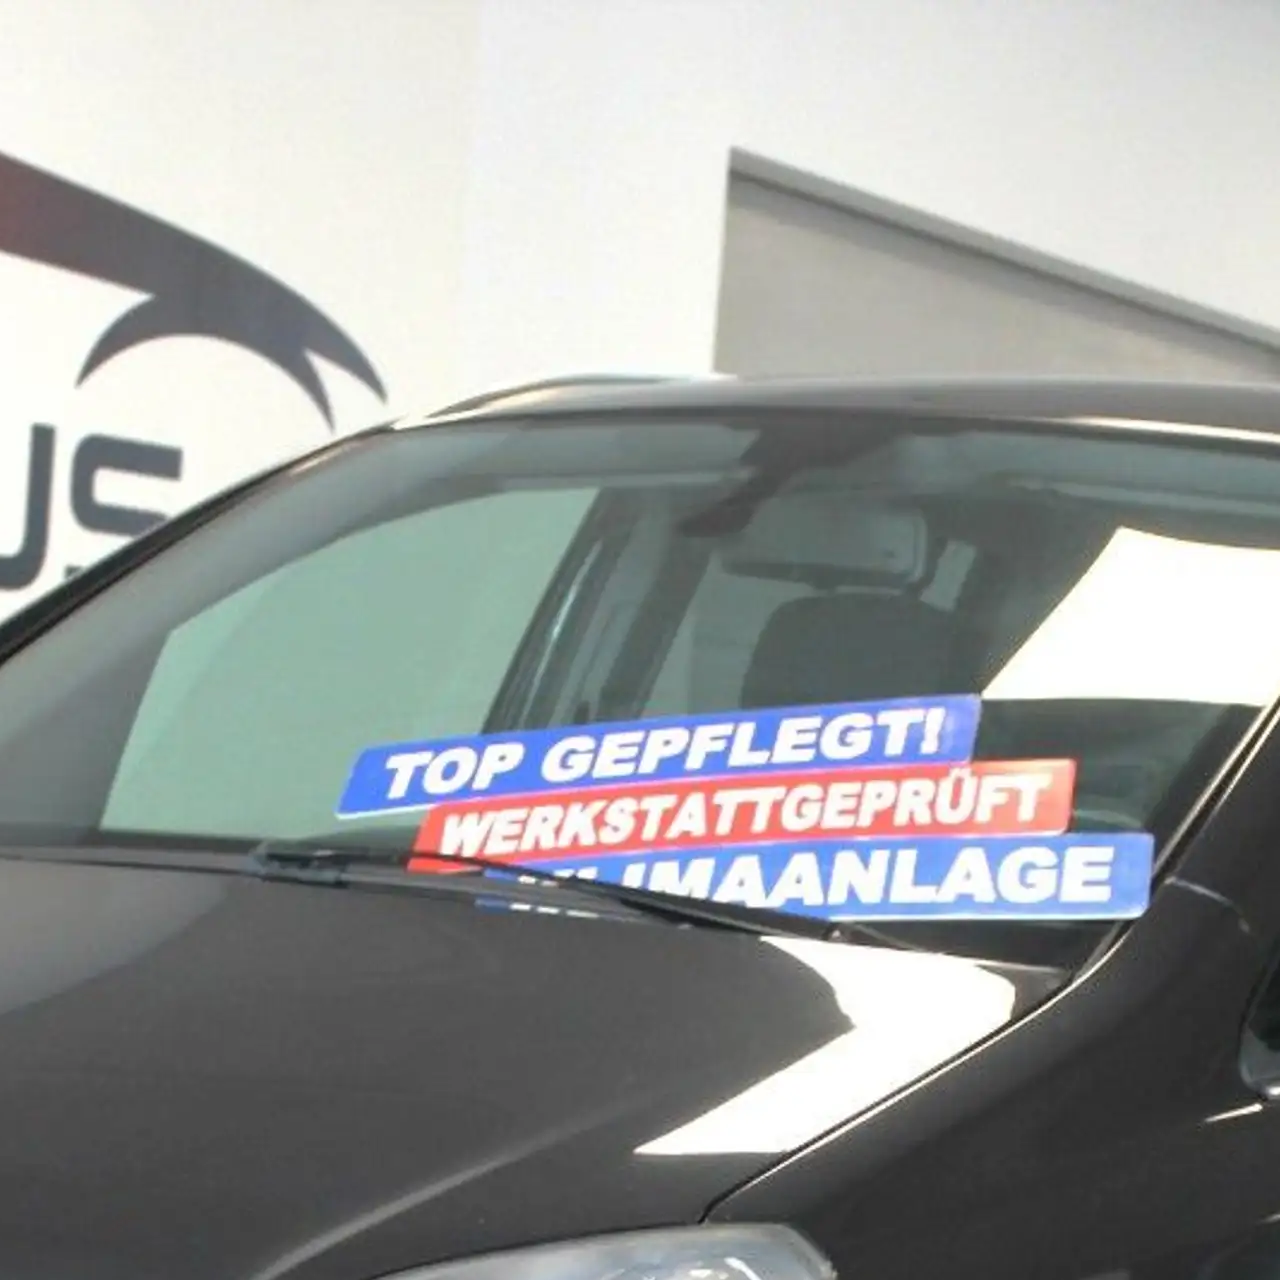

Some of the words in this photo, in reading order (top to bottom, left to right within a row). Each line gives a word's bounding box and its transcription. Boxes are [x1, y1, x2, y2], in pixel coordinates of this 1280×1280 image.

[384, 746, 526, 800] TOP
[540, 708, 945, 785] GEPFLEGT!
[440, 768, 1053, 858] WERKSTATTGEPRÜFT
